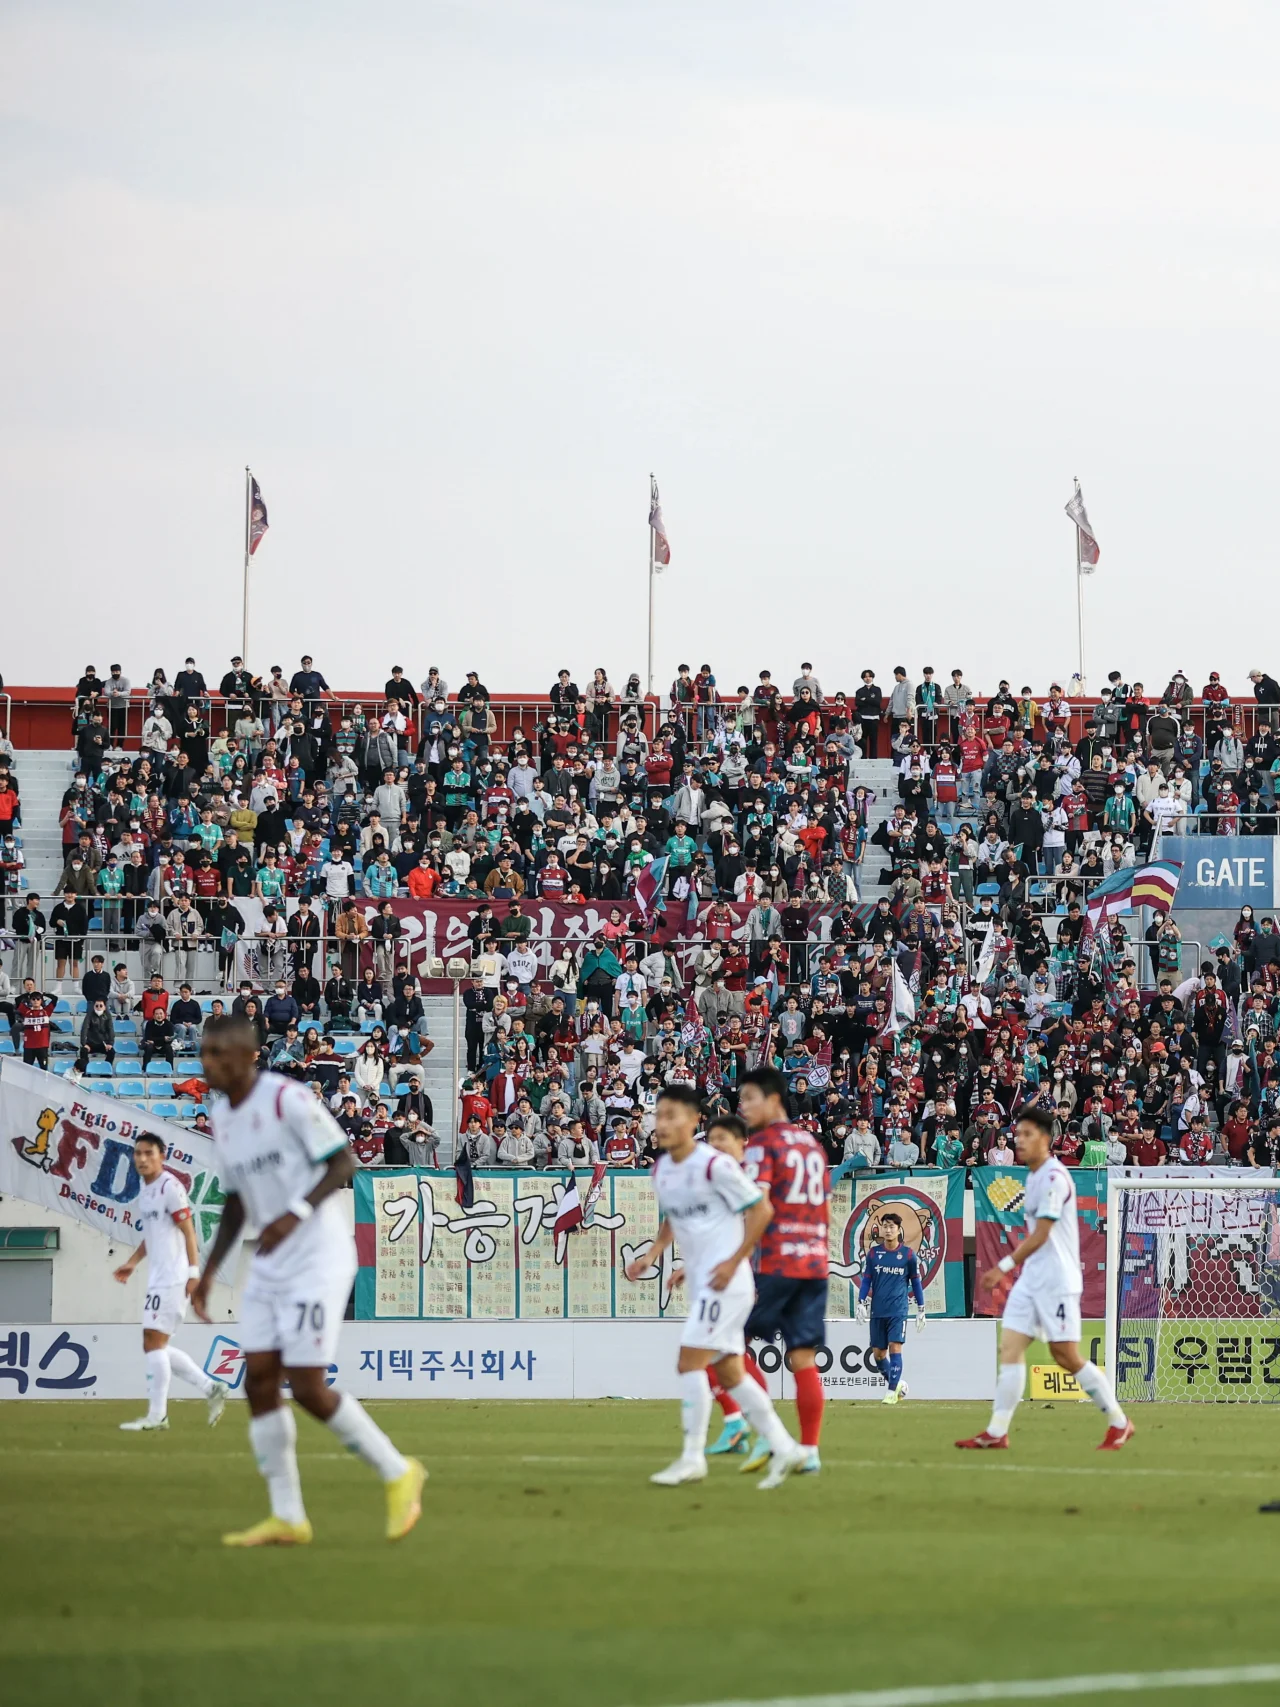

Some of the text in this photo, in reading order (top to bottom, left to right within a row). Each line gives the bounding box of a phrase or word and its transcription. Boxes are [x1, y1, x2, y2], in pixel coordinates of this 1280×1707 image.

[1196, 858, 1265, 887] GATE
[70, 1102, 117, 1132] Figlio
[785, 1150, 826, 1206] 28
[59, 1183, 118, 1222] Daejeon,
[145, 1294, 160, 1311] 20
[295, 1302, 324, 1332] 70
[699, 1299, 721, 1323] 10
[1055, 1303, 1066, 1321] 4
[359, 1349, 537, 1381] 지텍주식회사
[1043, 1371, 1082, 1394] 레모
